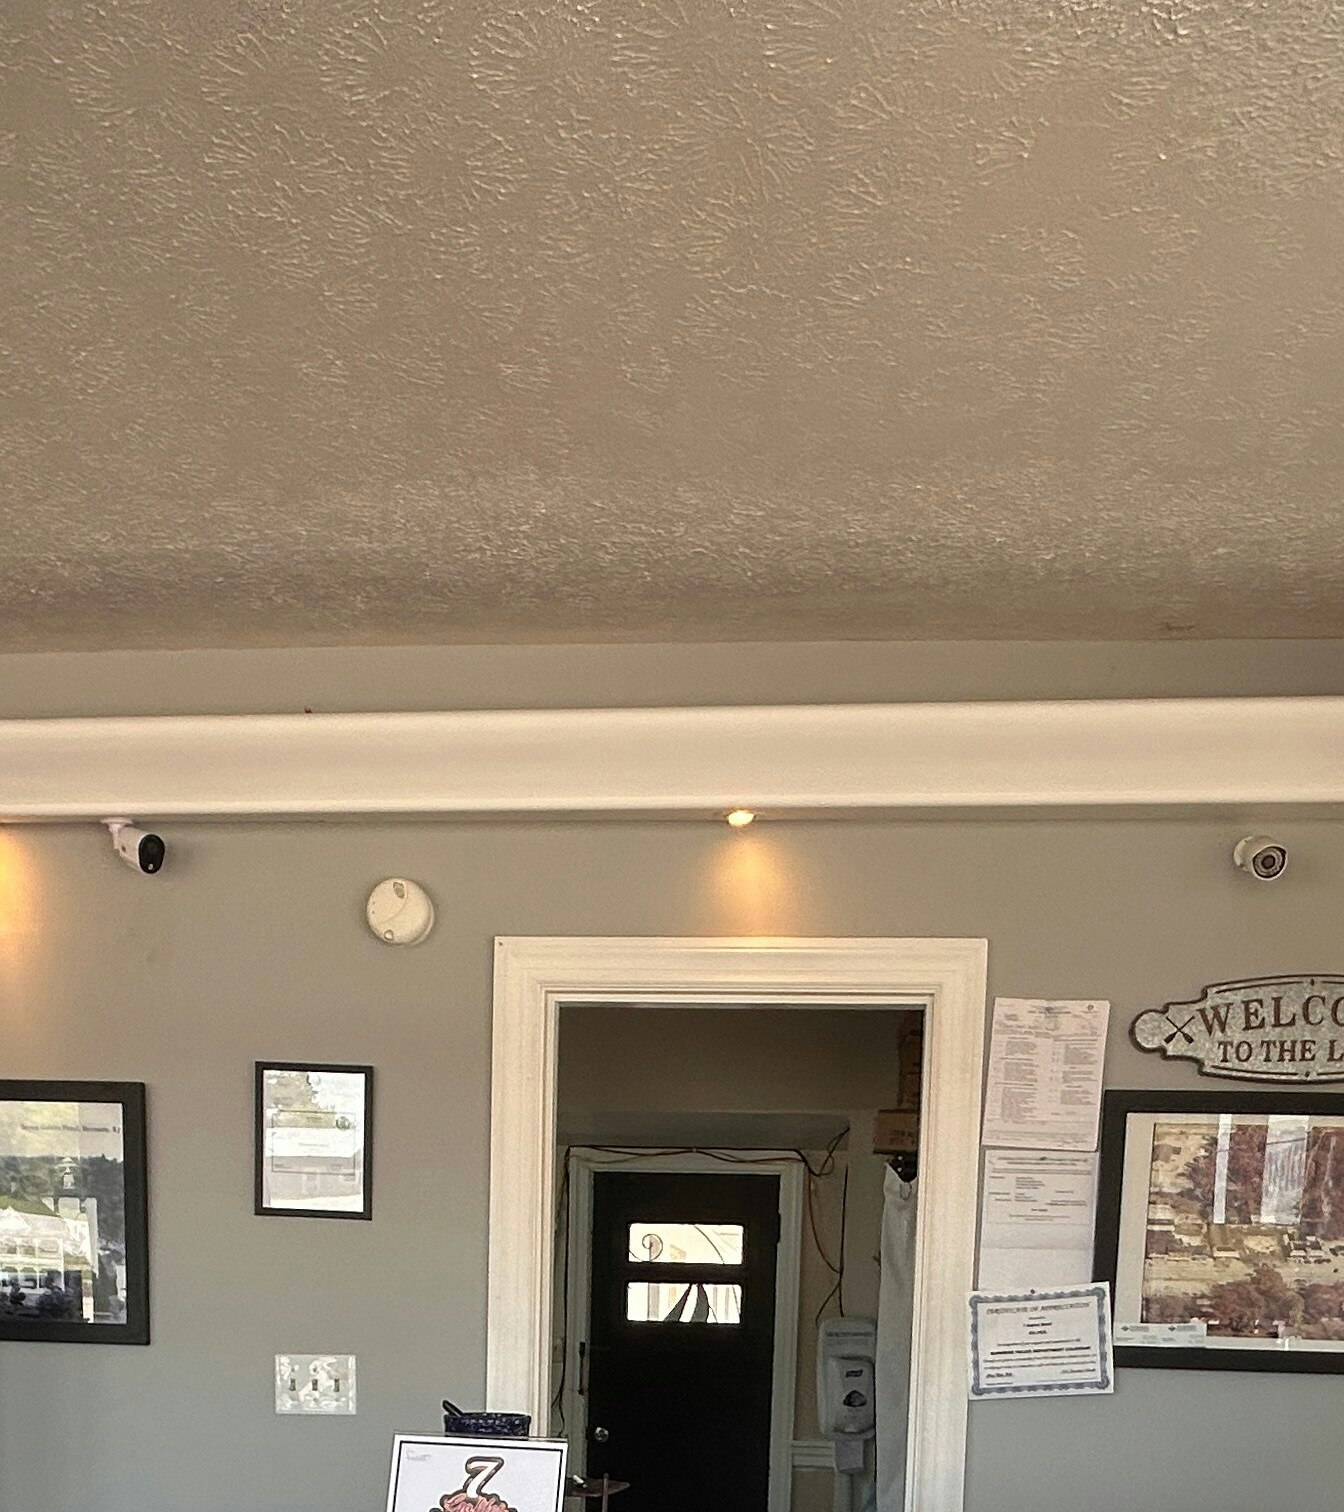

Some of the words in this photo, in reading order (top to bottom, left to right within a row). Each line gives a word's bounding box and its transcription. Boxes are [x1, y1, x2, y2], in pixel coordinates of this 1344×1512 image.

[1217, 1040, 1253, 1064] TO
[1260, 1039, 1317, 1063] THE
[465, 1457, 503, 1499] 7
